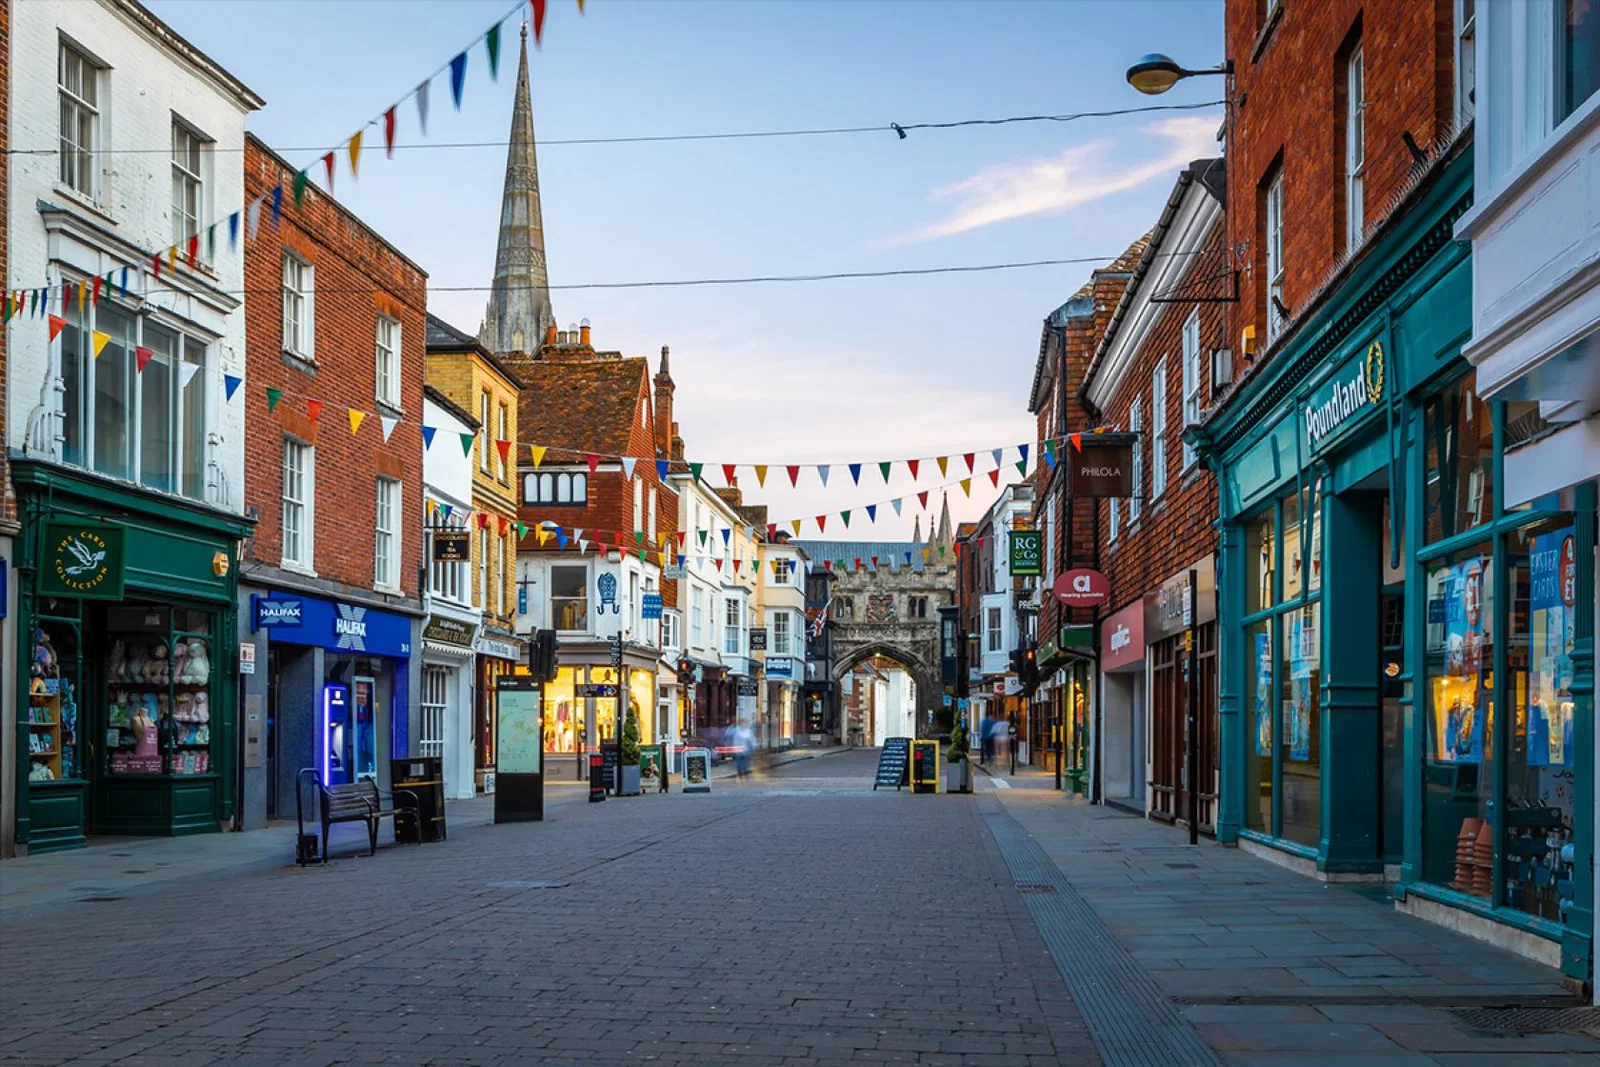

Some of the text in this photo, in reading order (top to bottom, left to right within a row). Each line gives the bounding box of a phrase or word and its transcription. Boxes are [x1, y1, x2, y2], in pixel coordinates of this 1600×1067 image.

[1305, 361, 1367, 447] Poundland
[1081, 466, 1121, 477] PHILOLA
[57, 531, 105, 552] THE CARD
[1015, 537, 1037, 549] RG
[1014, 550, 1038, 559] & Co
[1531, 549, 1558, 576] EASTER
[56, 559, 107, 590] COLLECTION
[1465, 574, 1480, 611] £1
[1532, 576, 1556, 601] CARDS
[1565, 577, 1575, 601] £1
[260, 607, 301, 617] HALIFAX
[336, 618, 366, 637] HALIFAX
